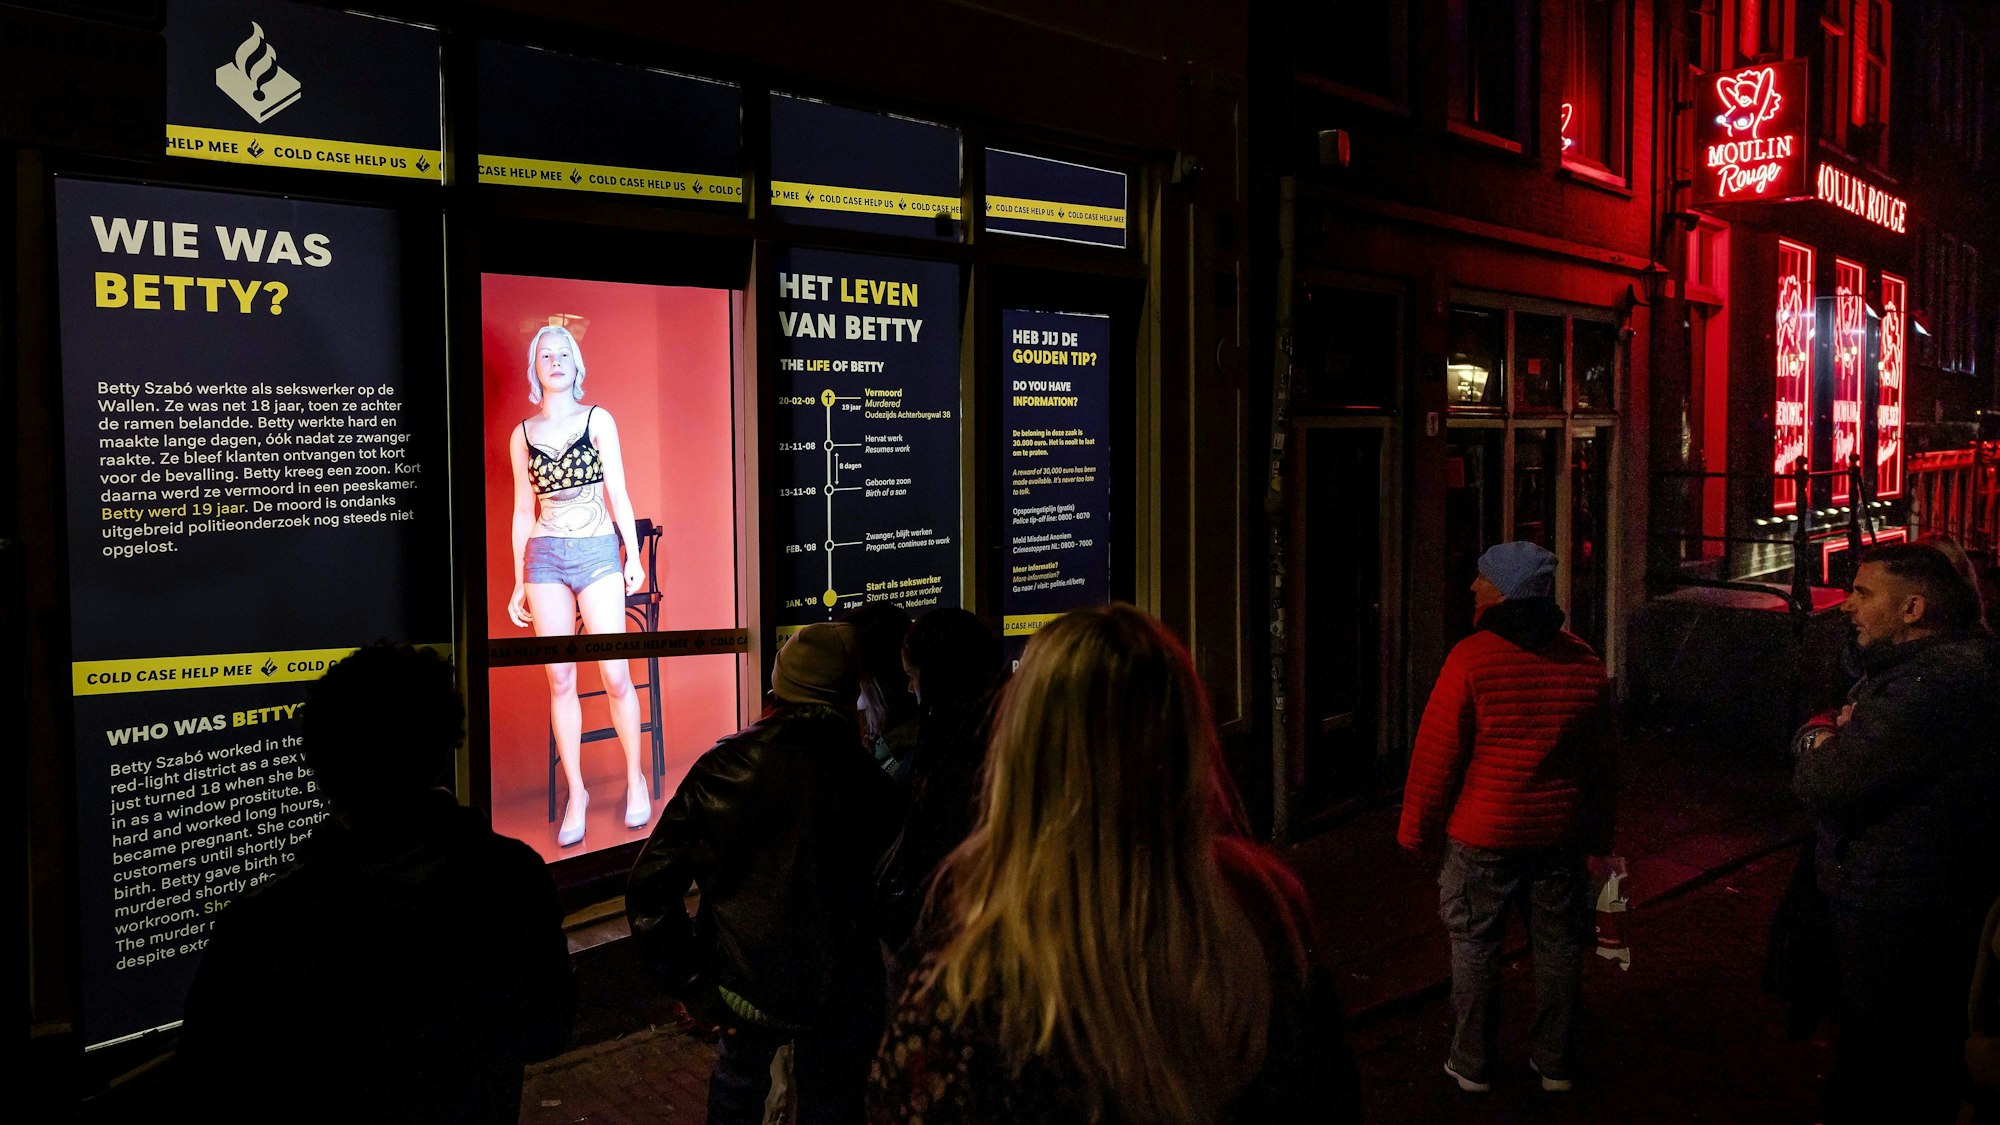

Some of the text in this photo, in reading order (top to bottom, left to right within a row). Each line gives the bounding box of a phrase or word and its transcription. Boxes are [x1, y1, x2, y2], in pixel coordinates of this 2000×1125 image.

[166, 136, 238, 153] HELP MEE
[1707, 135, 1793, 167] MOULIN
[274, 146, 406, 168] COLD CASE HELP US
[478, 164, 562, 181] CASE HELP MEE
[1718, 162, 1781, 197] Rouge
[588, 174, 686, 191] COLD CASE HELP US
[708, 184, 733, 194] COLD
[783, 191, 799, 200] MEE
[819, 194, 893, 208] COLD CASE HELP US
[911, 202, 930, 211] COLD
[931, 204, 950, 214] CASE
[995, 204, 1054, 216] COLD CASE HELP US
[1068, 211, 1083, 219] COLD
[1084, 212, 1098, 220] CASE
[1867, 186, 1907, 233] ROUGE
[90, 215, 332, 267] WIE WAS
[94, 271, 288, 315] BETTY?
[779, 272, 918, 307] HET LEVEN
[778, 311, 923, 342] VAN BETTY
[1012, 329, 1078, 347] HEB JIJ DE
[780, 358, 884, 372] THE LIFE OF BETTY
[1012, 348, 1096, 366] GOUDEN TIP?
[98, 381, 394, 398] Betty Szabó werkte als sekswerker op de
[864, 388, 902, 397] Vermoord
[1012, 380, 1071, 391] DO YOU HAVE
[97, 398, 402, 414] Wallen. Ze was net 18 jaar, toen ze achter
[778, 396, 815, 404] 20-02-09
[864, 398, 901, 408] Murdered
[1013, 396, 1078, 406] INFORMATION?
[98, 415, 396, 432] de ramen belandde. Betty werkte hard en
[99, 431, 411, 449] maakte lange dagen, óók nadat ze zwanger
[779, 441, 815, 450] 21-11-08
[864, 433, 903, 442] Hervat werk
[100, 446, 405, 466] raakte. Ze bleef klanten ontvangen tot kort
[864, 444, 910, 453] Resumes work
[865, 478, 895, 486] Geboorte
[780, 486, 816, 496] 13-11-08
[865, 488, 881, 497] Birth
[881, 487, 889, 496] of
[1027, 561, 1058, 571] informatie?
[866, 574, 941, 591] Start als sekswerker
[1010, 622, 1026, 630] CASE
[86, 664, 252, 684] COLD CASE HELP MEE
[287, 660, 324, 672] COLD
[106, 722, 168, 746] WHO
[173, 714, 226, 736] WAS
[110, 735, 303, 776] Betty Szabó worked in the
[110, 771, 180, 794] red-light
[183, 762, 236, 785] district
[237, 761, 256, 773] as
[260, 758, 268, 768] a
[272, 754, 297, 766] sex
[110, 770, 293, 815] just turned 18 when she
